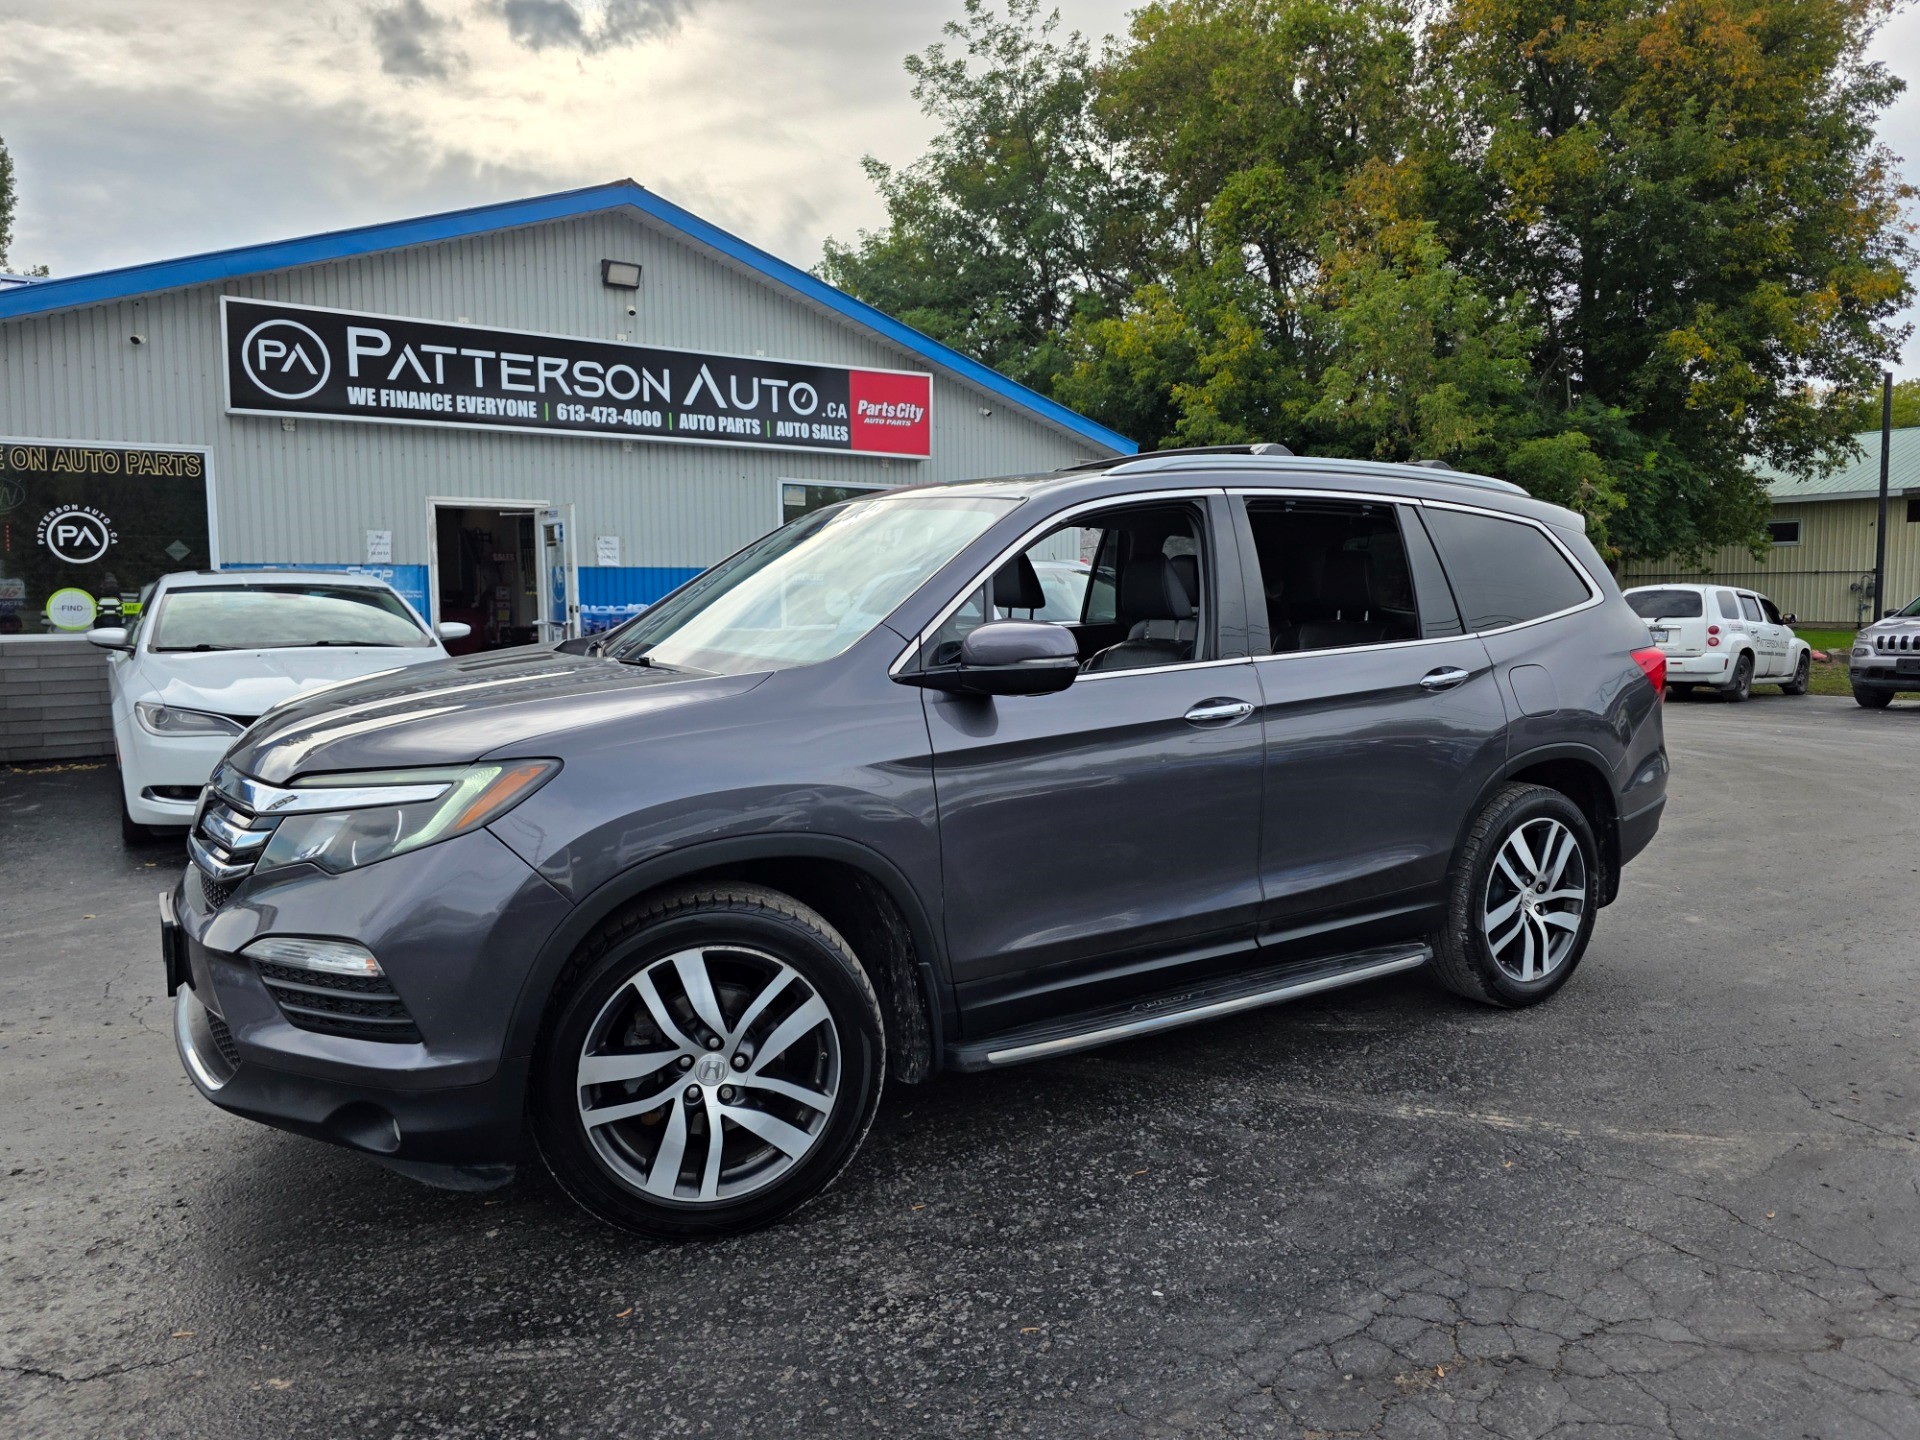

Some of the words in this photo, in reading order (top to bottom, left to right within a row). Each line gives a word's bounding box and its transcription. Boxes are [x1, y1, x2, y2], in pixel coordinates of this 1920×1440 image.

[347, 326, 671, 403] PATTERSON
[683, 363, 819, 416] AUTO
[347, 386, 377, 406] WE
[380, 389, 453, 413] FINANCE
[456, 398, 538, 419] EVERYONE
[556, 403, 662, 428] 613-473-4000
[679, 412, 716, 432] AUTO
[718, 416, 761, 436] PARTS
[776, 420, 809, 439] AUTO
[812, 423, 849, 442] SALES
[863, 417, 885, 425] AUTO
[886, 418, 912, 427] PARTS
[10, 446, 48, 472] ON
[52, 448, 120, 474] AUTO
[125, 450, 201, 477] PARTS
[37, 503, 79, 545] PATTERSON
[83, 505, 111, 525] AUTO
